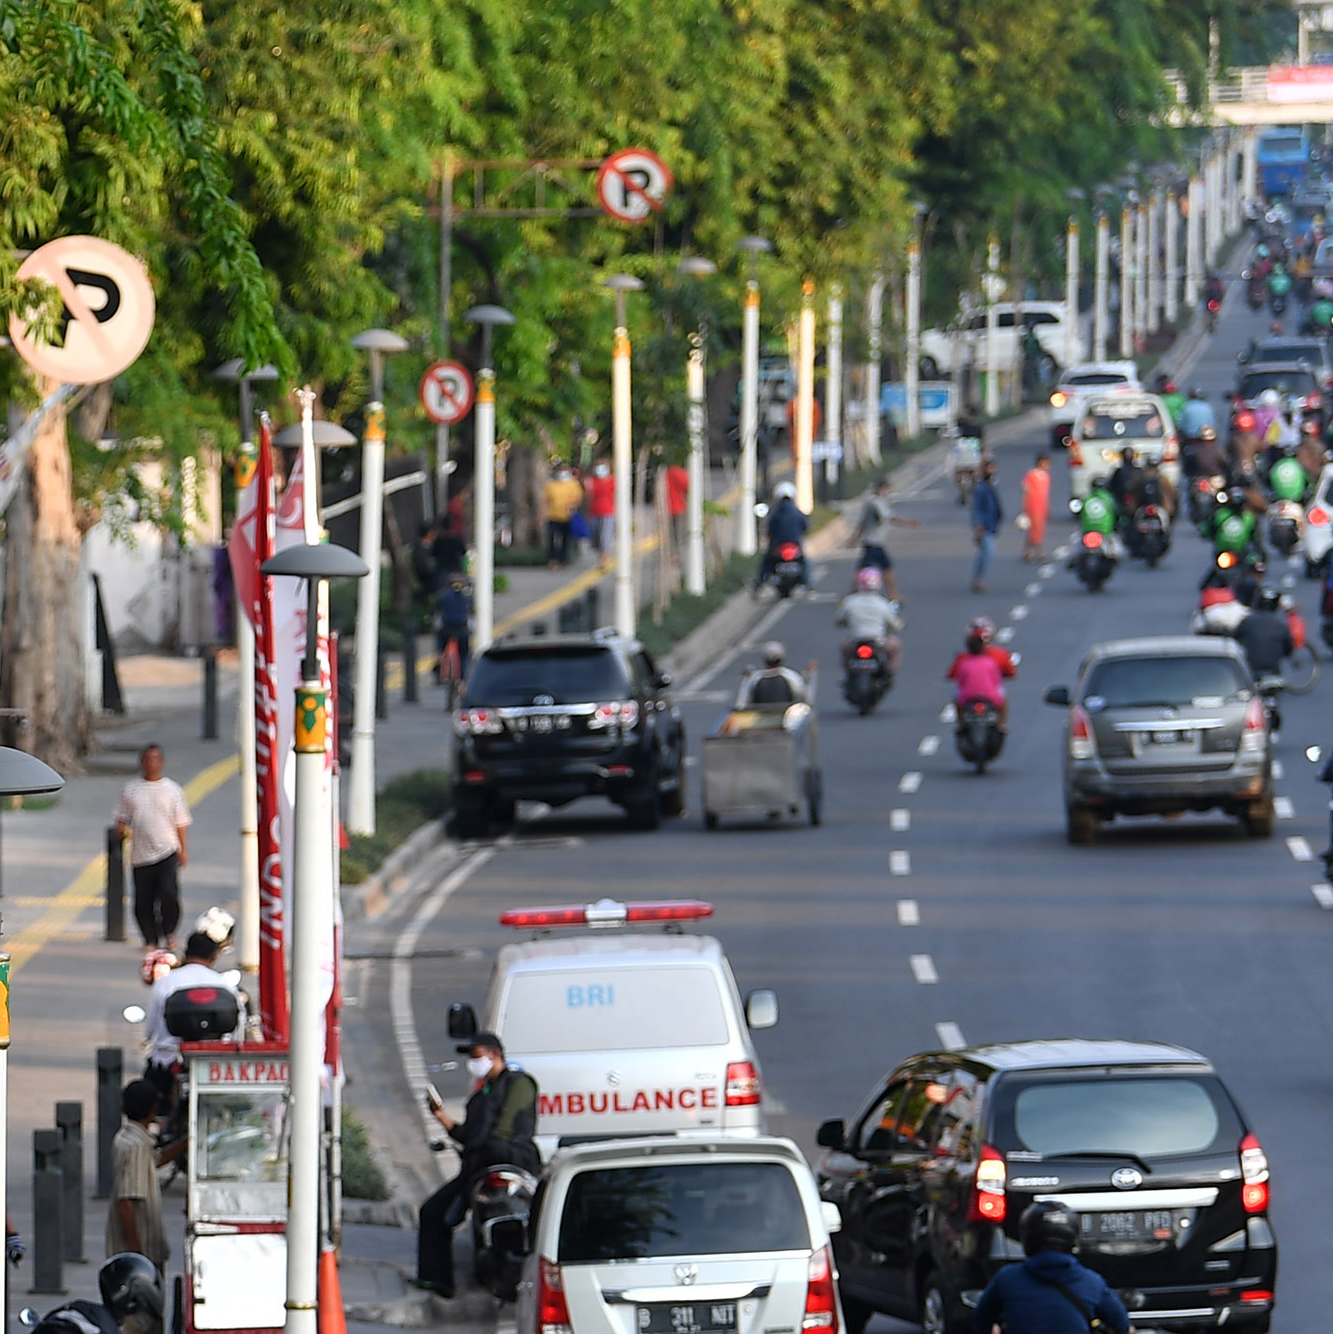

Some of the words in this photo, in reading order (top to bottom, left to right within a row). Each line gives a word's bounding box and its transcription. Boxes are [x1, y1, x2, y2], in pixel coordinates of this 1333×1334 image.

[566, 984, 615, 1008] BRI
[538, 1087, 718, 1115] MBULANCE
[638, 1308, 651, 1328] B
